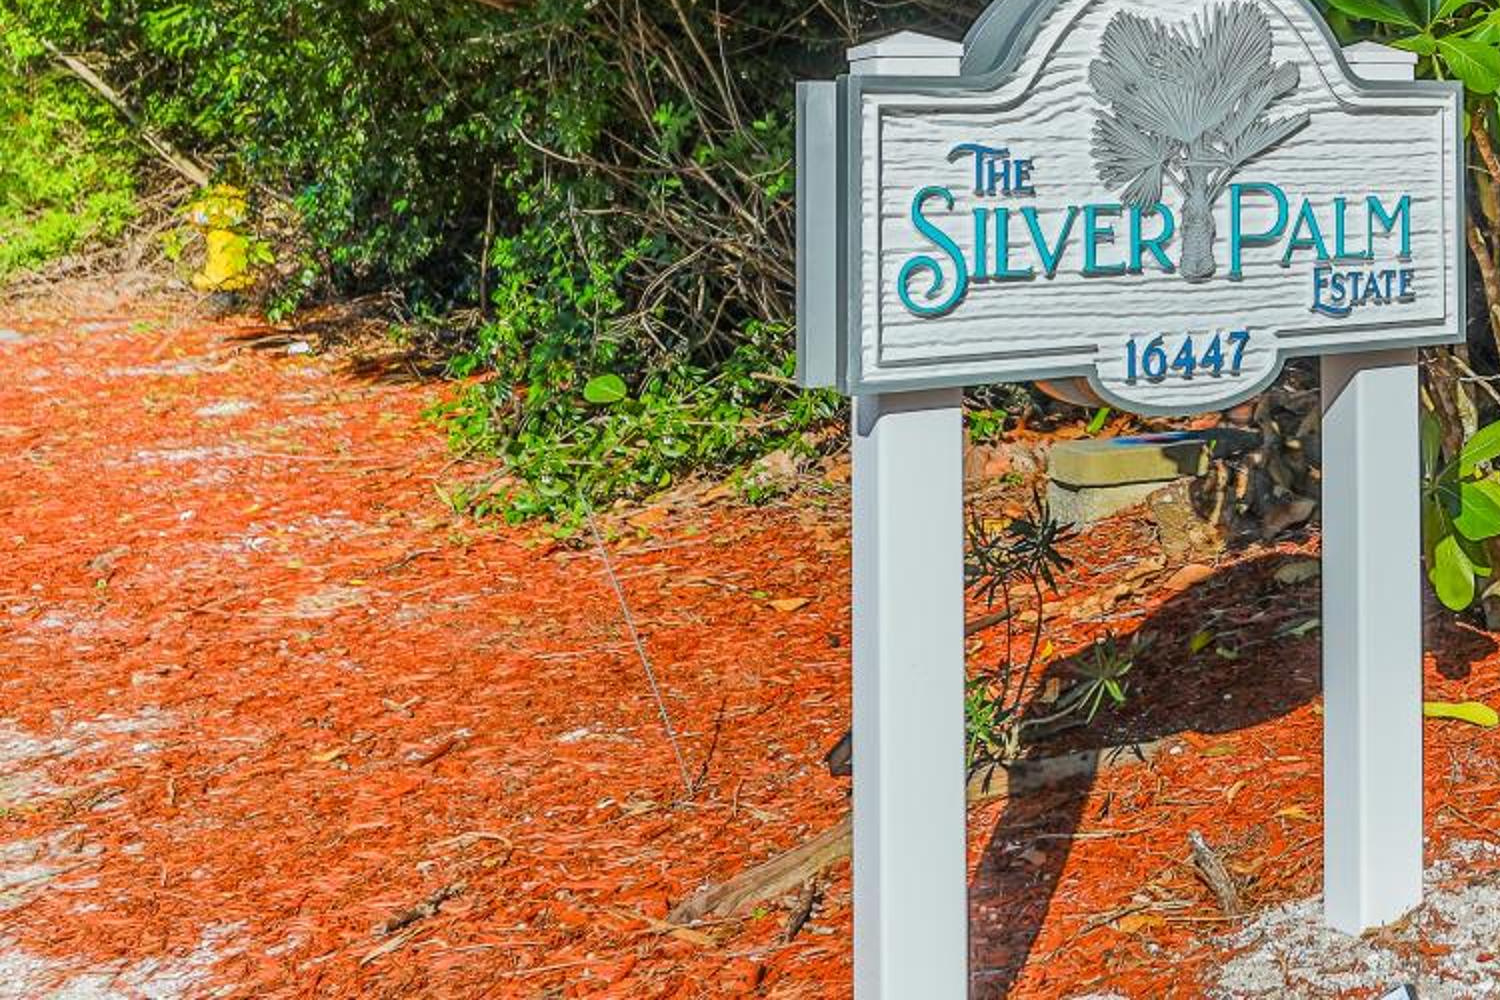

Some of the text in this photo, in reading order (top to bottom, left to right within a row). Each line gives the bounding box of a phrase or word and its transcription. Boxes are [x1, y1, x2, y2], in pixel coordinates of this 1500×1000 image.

[948, 142, 1036, 197] THE
[897, 181, 1412, 317] SILVER PALM
[1311, 264, 1416, 316] ESTATE
[1124, 329, 1250, 383] 16447
